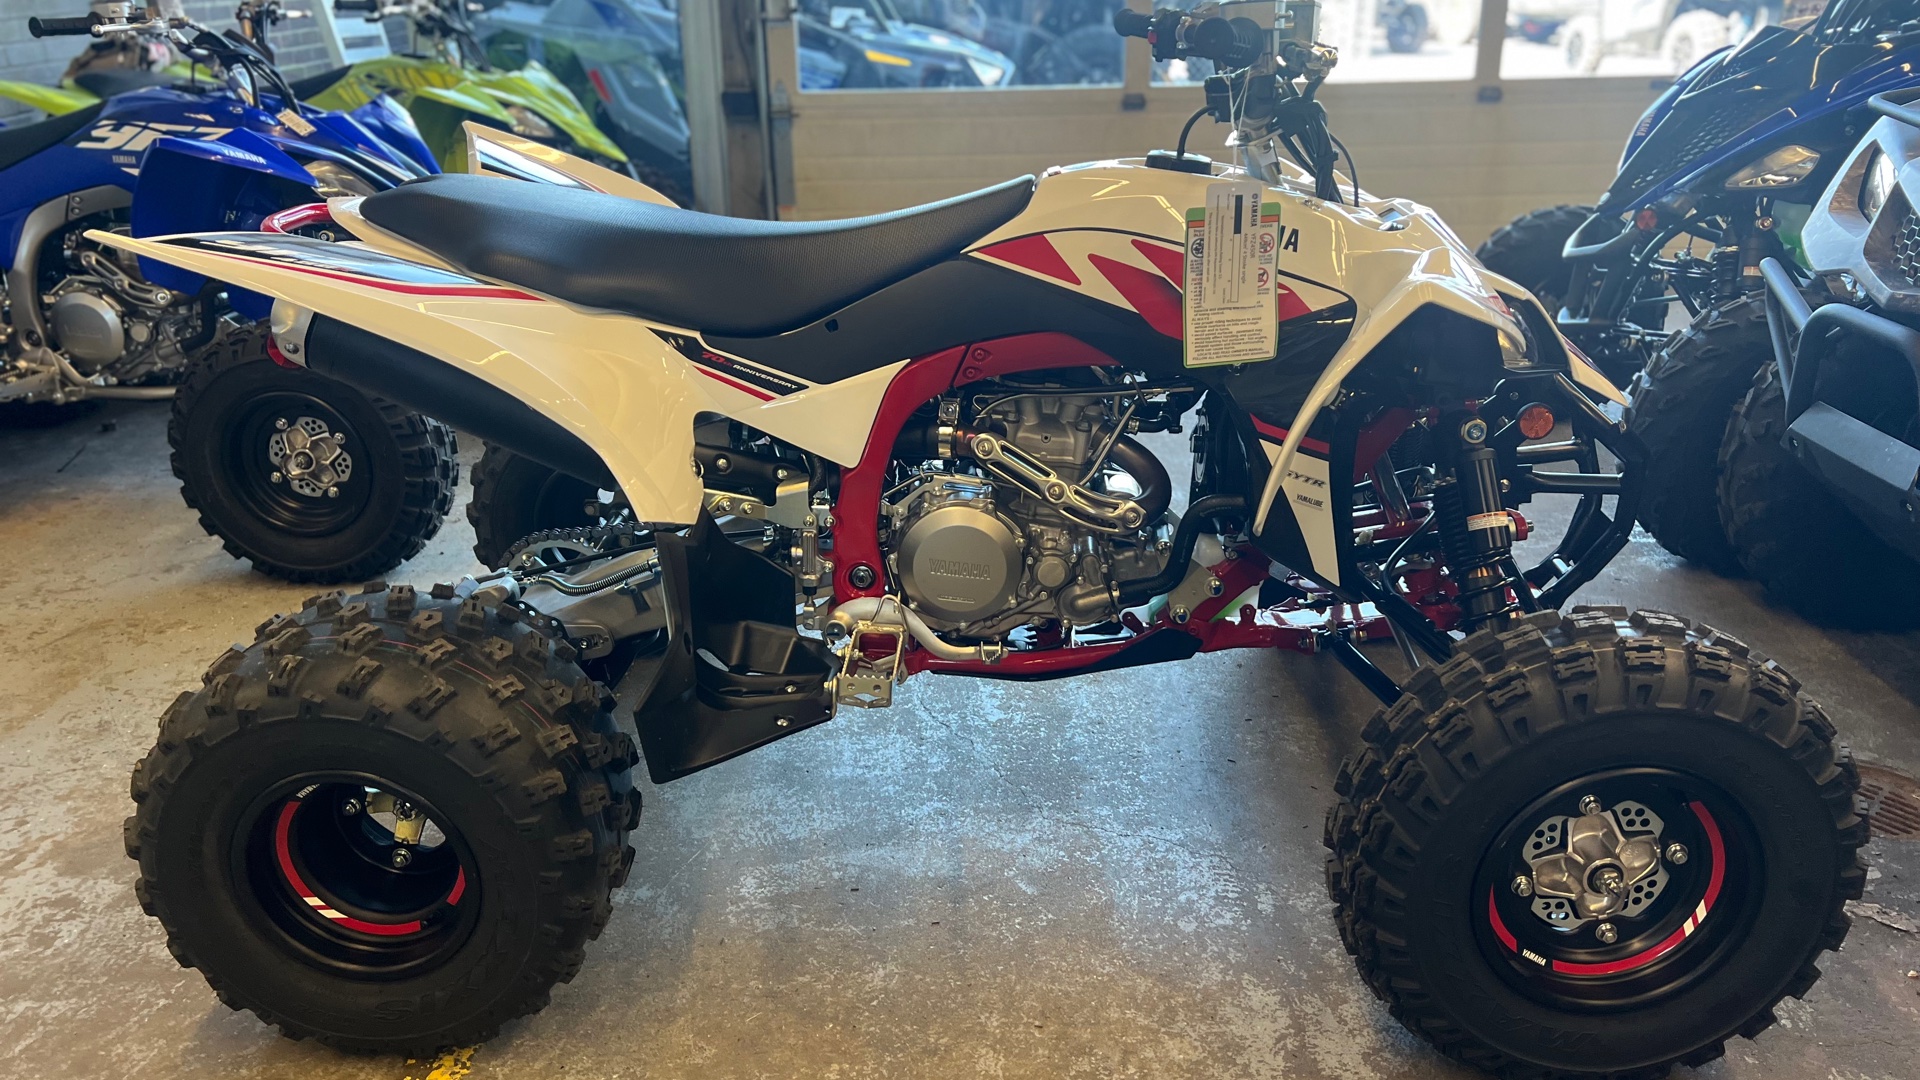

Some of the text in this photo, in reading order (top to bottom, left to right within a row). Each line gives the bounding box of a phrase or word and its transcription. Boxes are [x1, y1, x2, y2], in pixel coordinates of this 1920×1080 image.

[112, 155, 137, 165] YAMAHA
[222, 148, 267, 165] YAMAHA
[1250, 200, 1259, 228] YAMAHA
[733, 364, 798, 390] ANNIVERSARY
[1296, 493, 1324, 508] YAMALUBE
[928, 558, 991, 581] YAMAHA
[295, 783, 320, 799] AMAHA
[1522, 948, 1547, 967] YAMAHA
